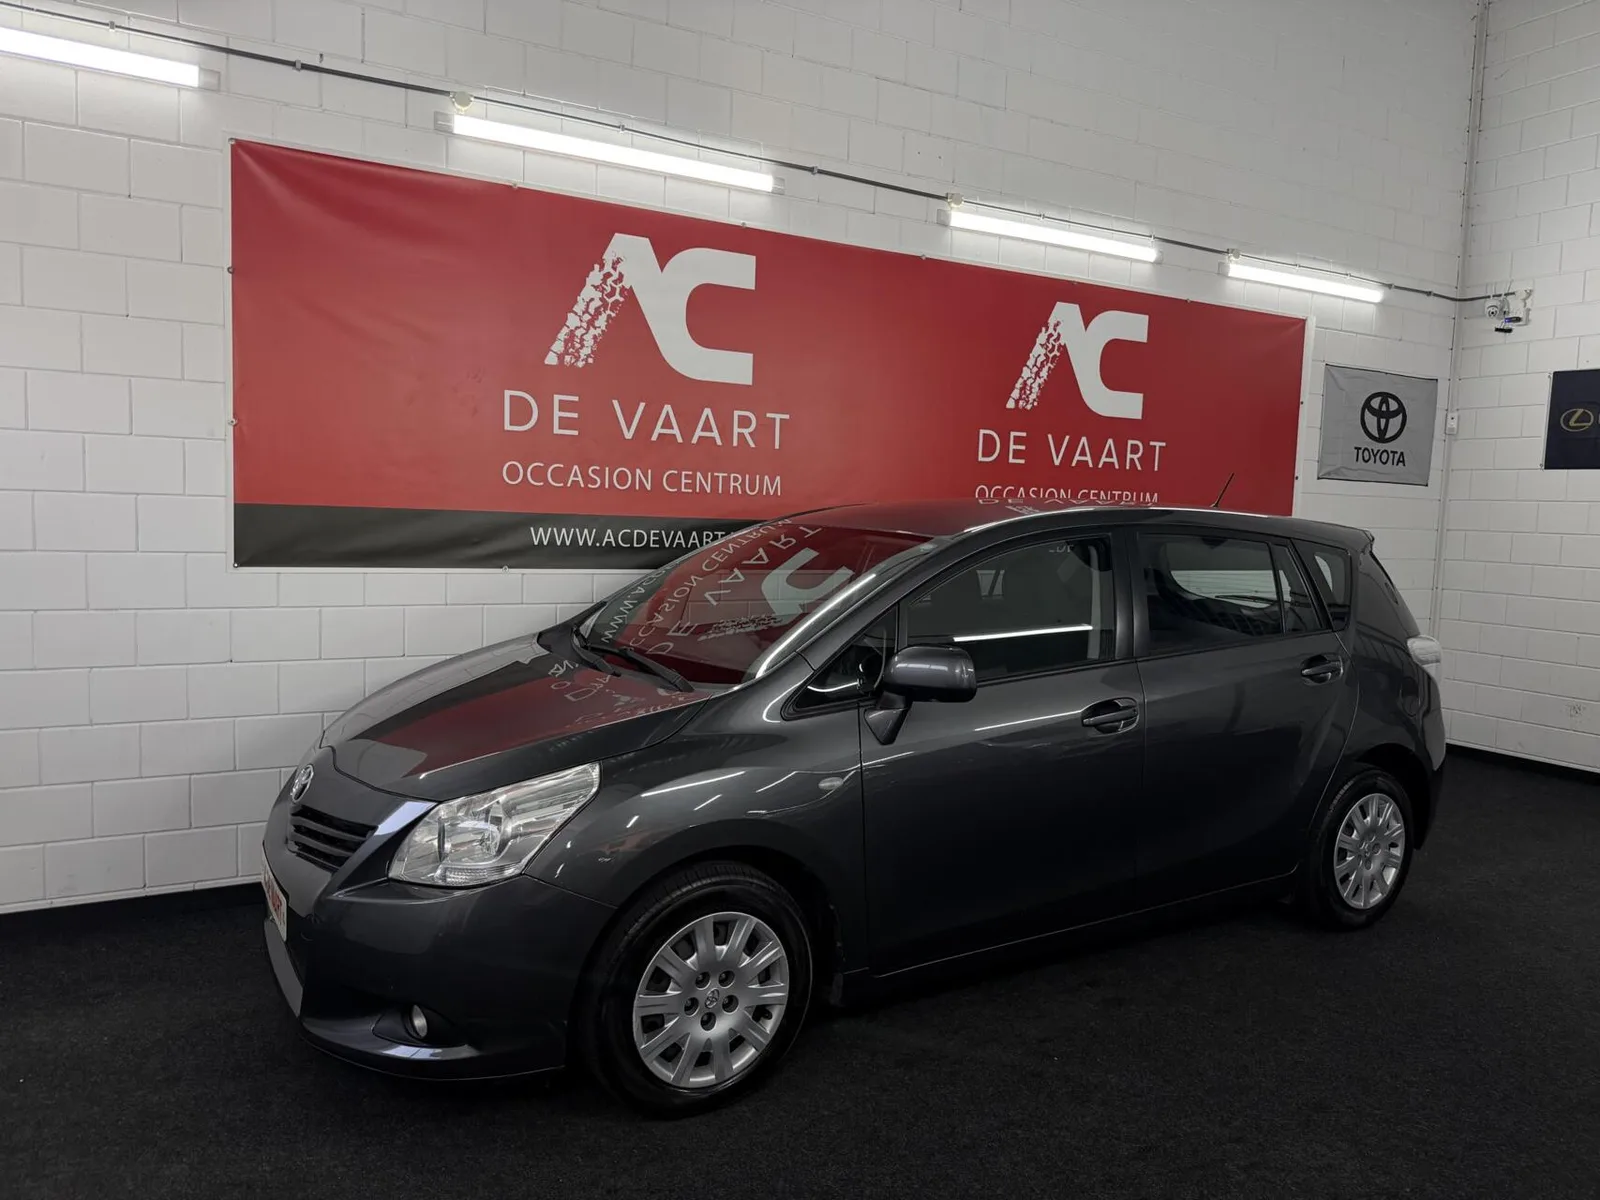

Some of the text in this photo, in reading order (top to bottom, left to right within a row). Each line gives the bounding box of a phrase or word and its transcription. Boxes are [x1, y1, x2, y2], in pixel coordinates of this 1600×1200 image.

[544, 232, 756, 386] AC
[1005, 301, 1149, 420] AC
[503, 389, 790, 450] DE VAART
[977, 428, 1166, 472] DE VAART
[1353, 446, 1406, 467] TOYOTA
[502, 460, 782, 496] OCCASION CENTRUM
[975, 484, 1071, 500] OCCASION
[530, 526, 725, 548] WWW.ACDEVAART
